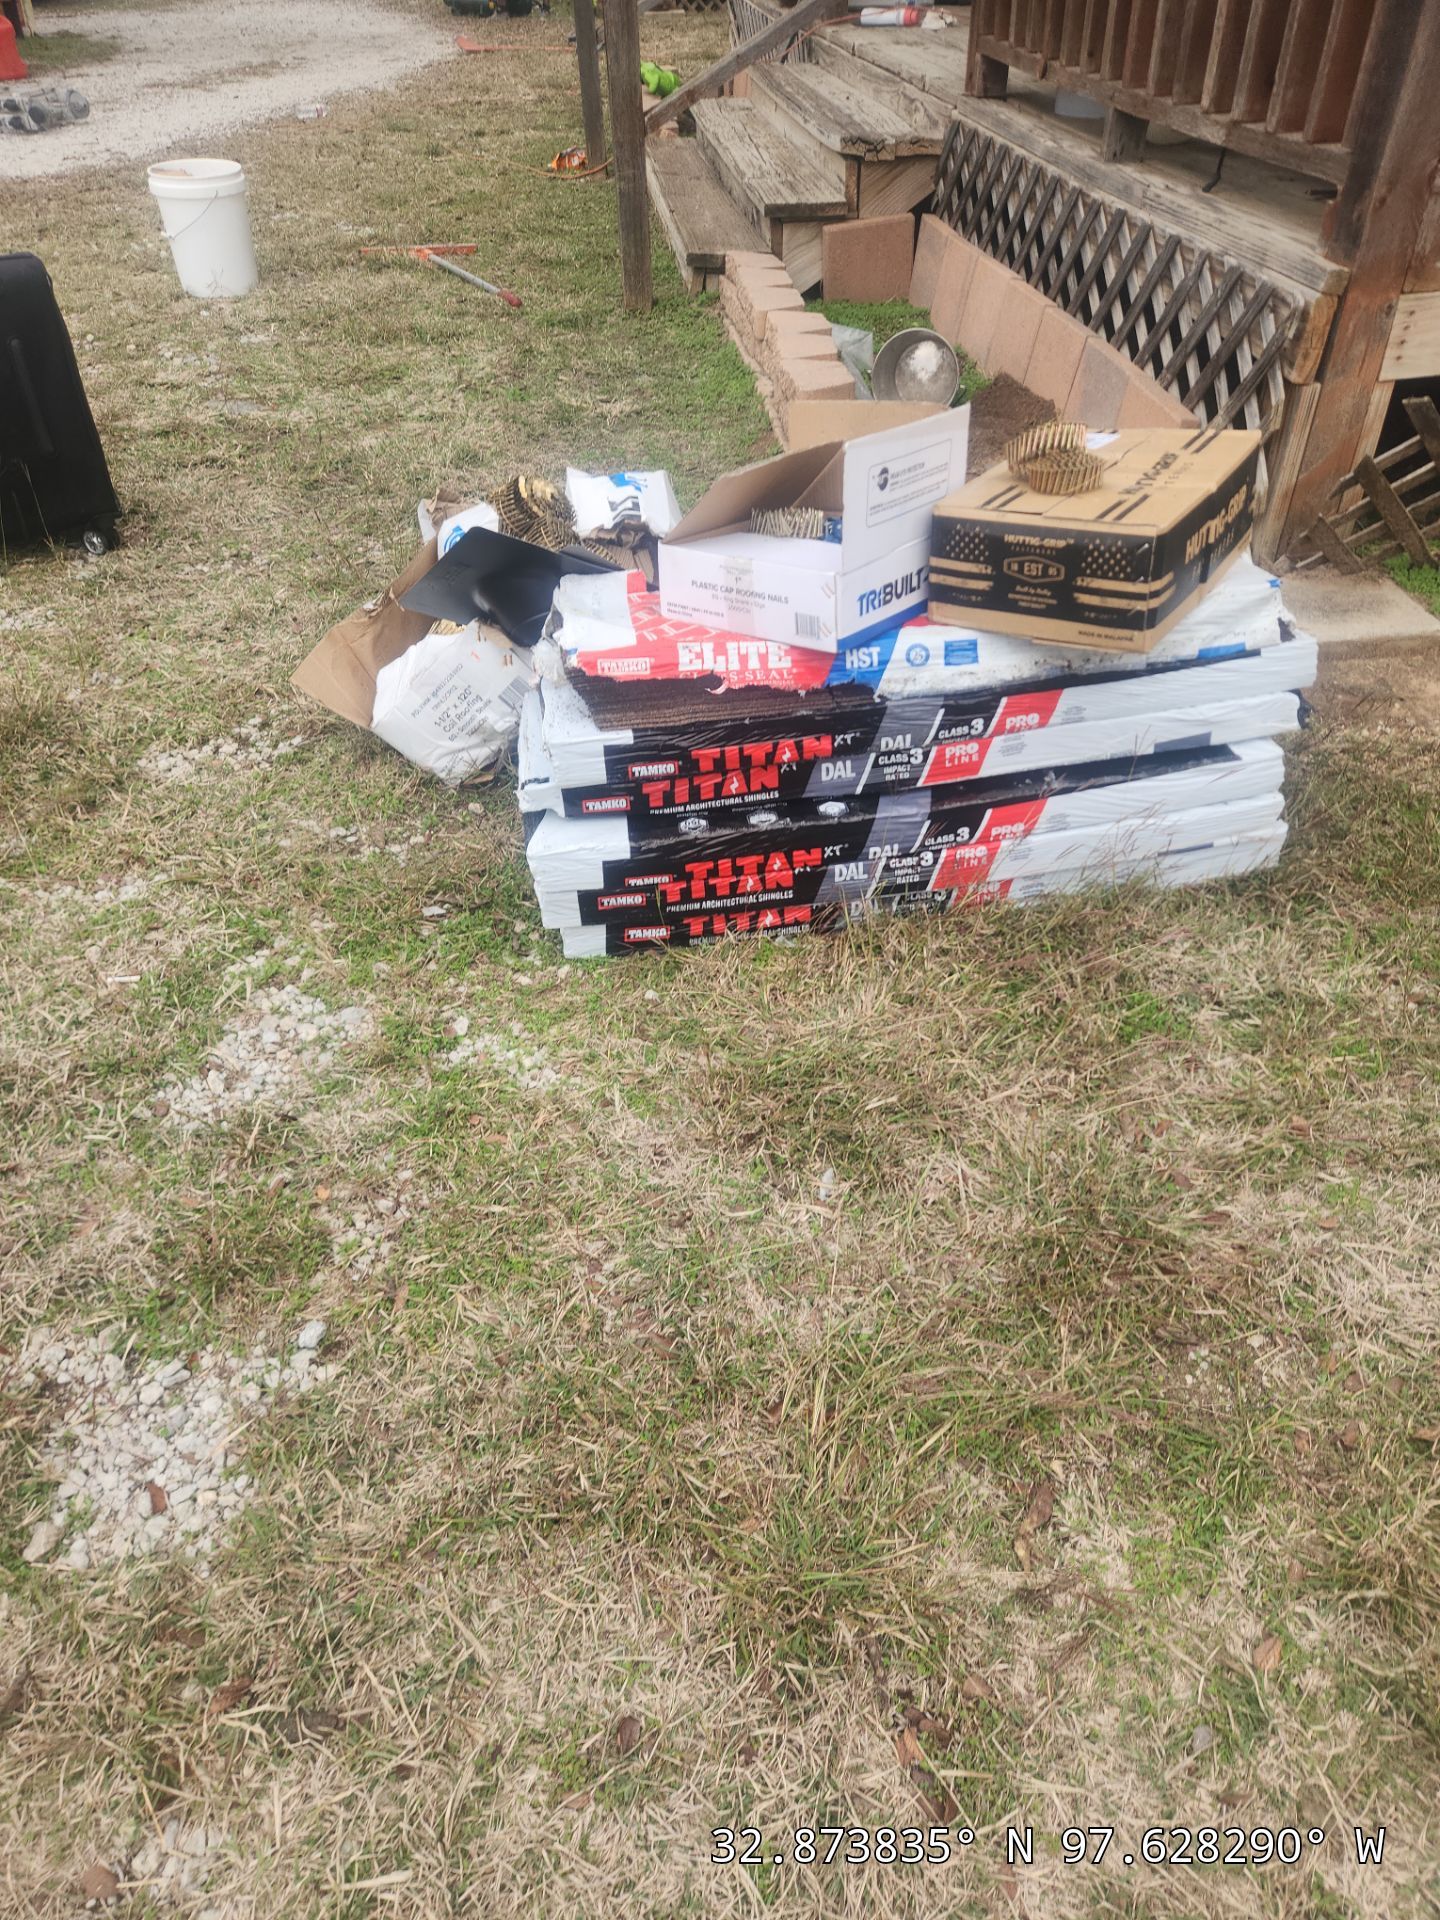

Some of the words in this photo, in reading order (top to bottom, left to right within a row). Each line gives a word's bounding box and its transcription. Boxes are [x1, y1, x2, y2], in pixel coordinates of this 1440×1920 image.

[1023, 562, 1044, 576] EST
[691, 579, 719, 592] PLASTIC
[719, 585, 734, 594] CAP
[767, 593, 789, 605] NAILS
[677, 641, 792, 672] ELITE
[845, 646, 880, 669] HST
[599, 659, 648, 674] TAMKO
[455, 694, 483, 722] Roofing
[938, 725, 970, 740] CLASS
[970, 717, 985, 735] 3
[1005, 712, 1040, 730] PRO
[834, 732, 855, 748] XT
[880, 733, 914, 752] DAL
[691, 735, 832, 773] TITAN
[878, 753, 909, 766] CLASS
[909, 748, 924, 765] 3
[945, 742, 979, 759] PRO
[884, 764, 911, 775] IMPACT
[945, 753, 979, 768] LINE
[631, 764, 676, 777] TAMKO
[821, 760, 856, 782] DAL
[885, 772, 910, 782] RATED
[642, 766, 780, 808] TITAN
[586, 798, 628, 810] TAMKO
[686, 796, 743, 811] ARCHITECTURAL
[744, 790, 780, 803] SHINGLES
[924, 833, 956, 846] CLASS
[956, 826, 971, 842] 3
[991, 822, 1025, 837] PRO
[824, 844, 843, 859] XT
[868, 843, 901, 860] DAL
[919, 851, 934, 867] 3
[685, 847, 822, 880] TITAN
[834, 861, 869, 883] DAL
[628, 875, 669, 887] TAMKO
[658, 870, 794, 904] TITAN
[896, 874, 920, 885] RATED
[600, 894, 643, 908] TAMKO
[666, 903, 700, 913] PREMIUM
[701, 895, 757, 910] ARCHITECTURAL
[758, 889, 794, 902] SHINGLES
[683, 906, 812, 937] TITAN
[628, 926, 667, 940] TAMKO
